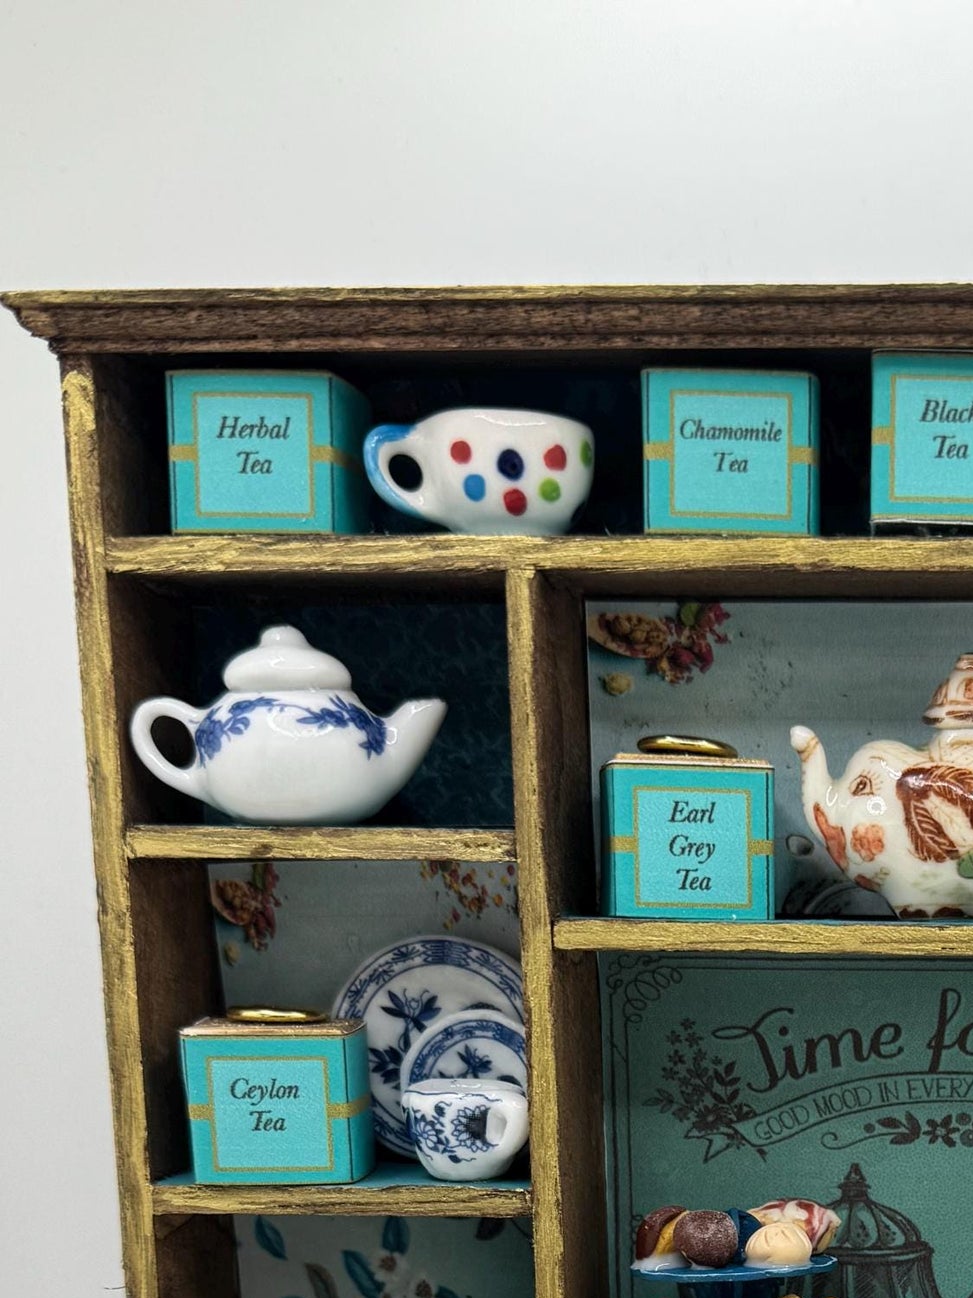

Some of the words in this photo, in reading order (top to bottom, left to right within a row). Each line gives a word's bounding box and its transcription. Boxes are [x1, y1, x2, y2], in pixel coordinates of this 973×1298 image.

[216, 415, 291, 440] Herbal
[679, 418, 783, 443] Chamomile
[932, 434, 969, 460] Tea
[236, 450, 273, 475] Tea
[713, 451, 749, 474] Tea
[667, 800, 717, 824] Earl
[668, 834, 716, 865] Grey
[675, 868, 712, 892] Tea
[711, 1007, 904, 1093] Time
[229, 1077, 300, 1107] Ceylon
[248, 1109, 287, 1132] Tea
[754, 1104, 810, 1141] GOOD
[812, 1086, 873, 1118] MOOD
[878, 1080, 899, 1102] IN
